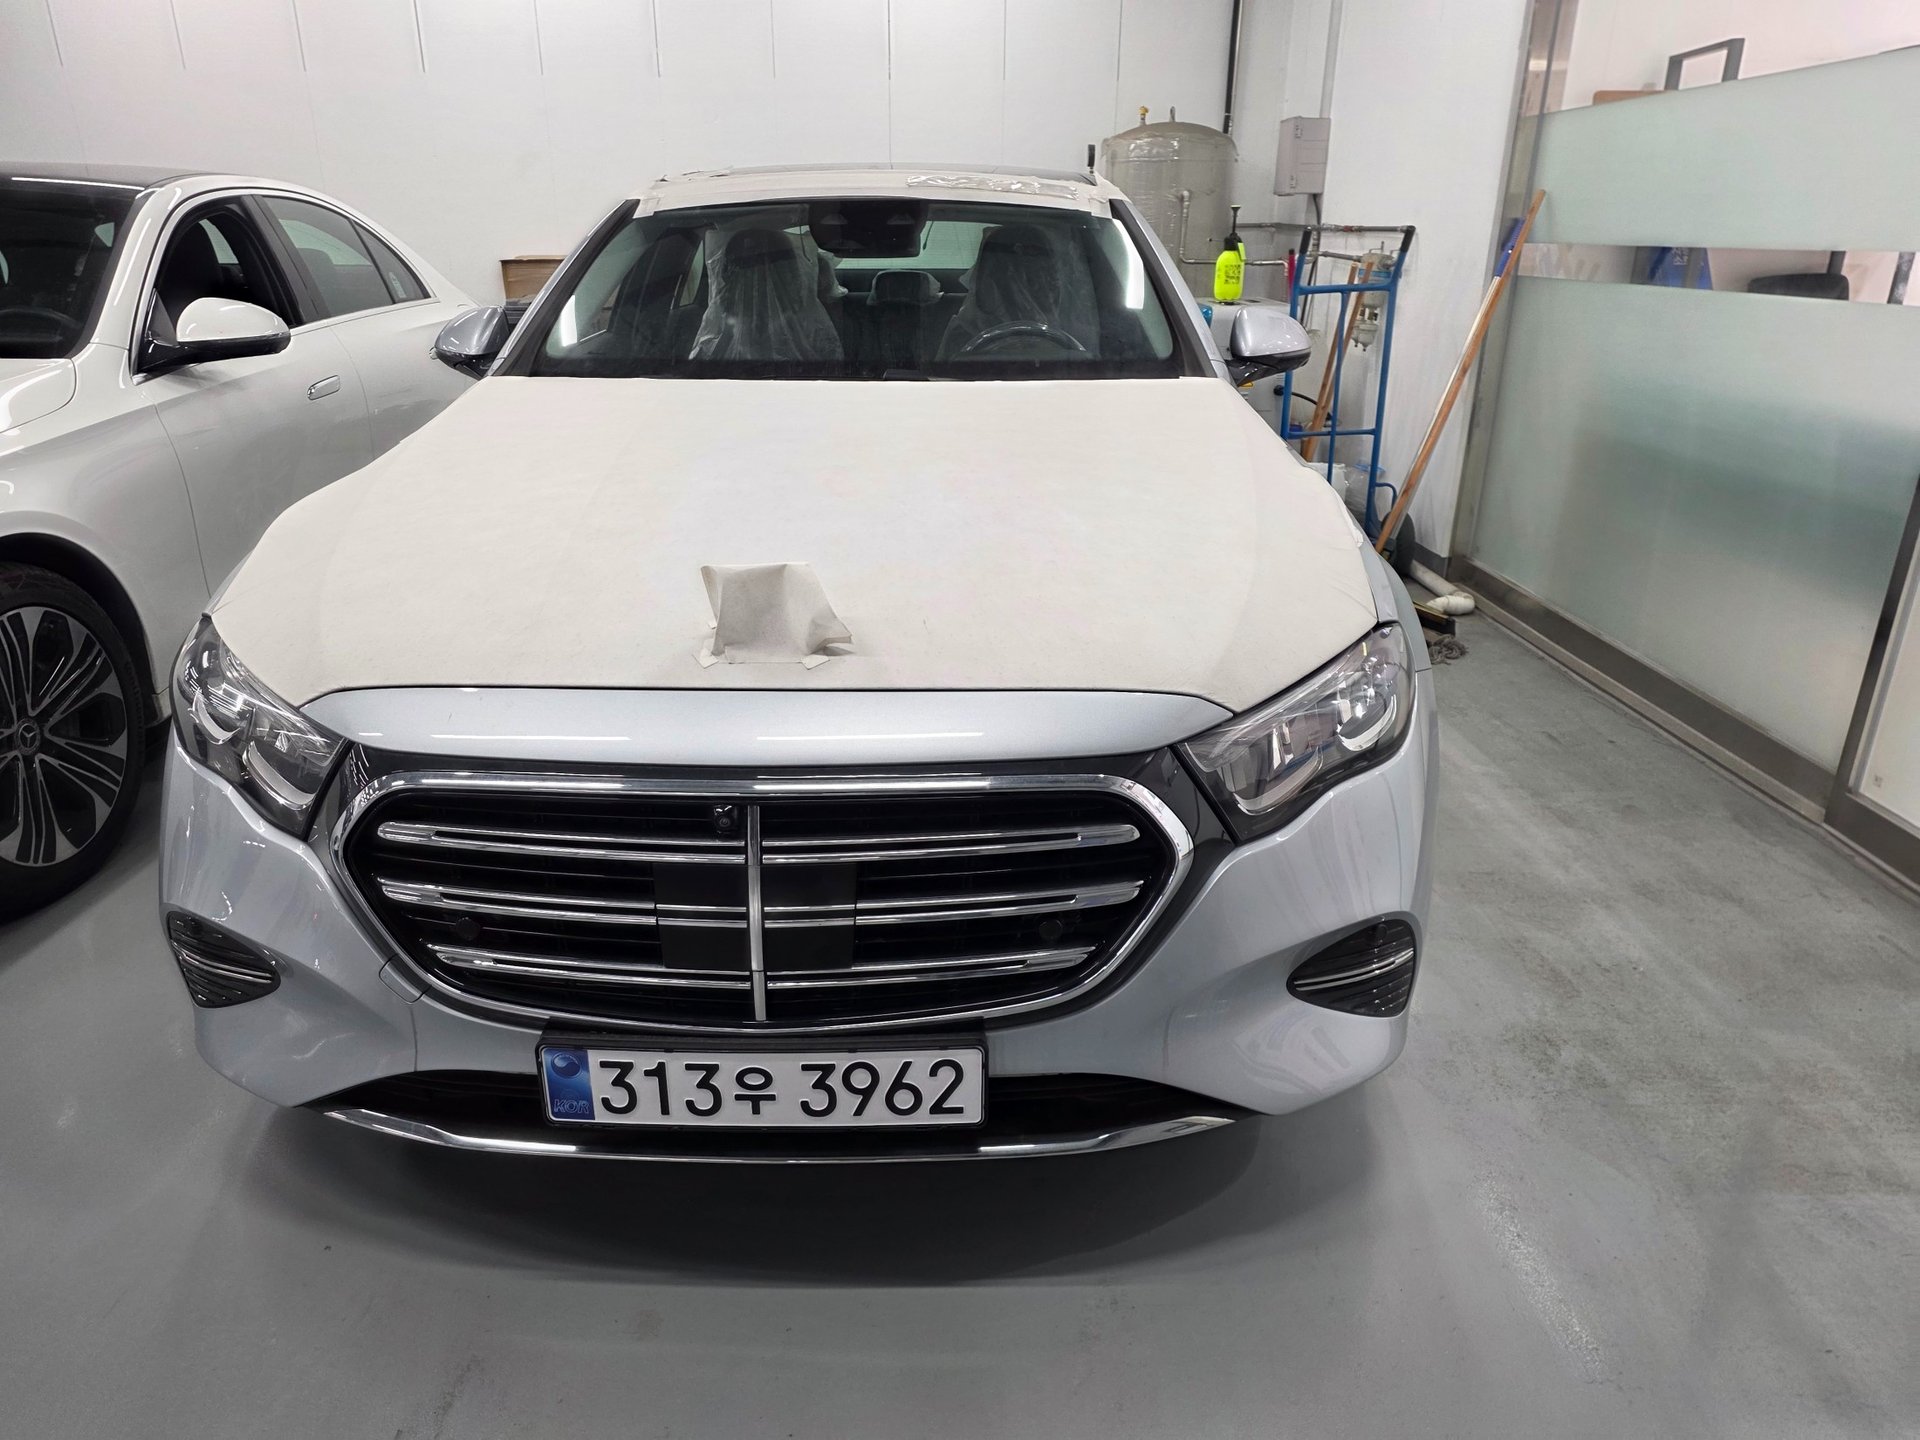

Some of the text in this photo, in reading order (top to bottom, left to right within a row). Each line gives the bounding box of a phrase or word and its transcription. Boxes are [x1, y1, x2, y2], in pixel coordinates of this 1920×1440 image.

[600, 1059, 965, 1117] 313우 3962
[553, 1099, 590, 1114] KOR
